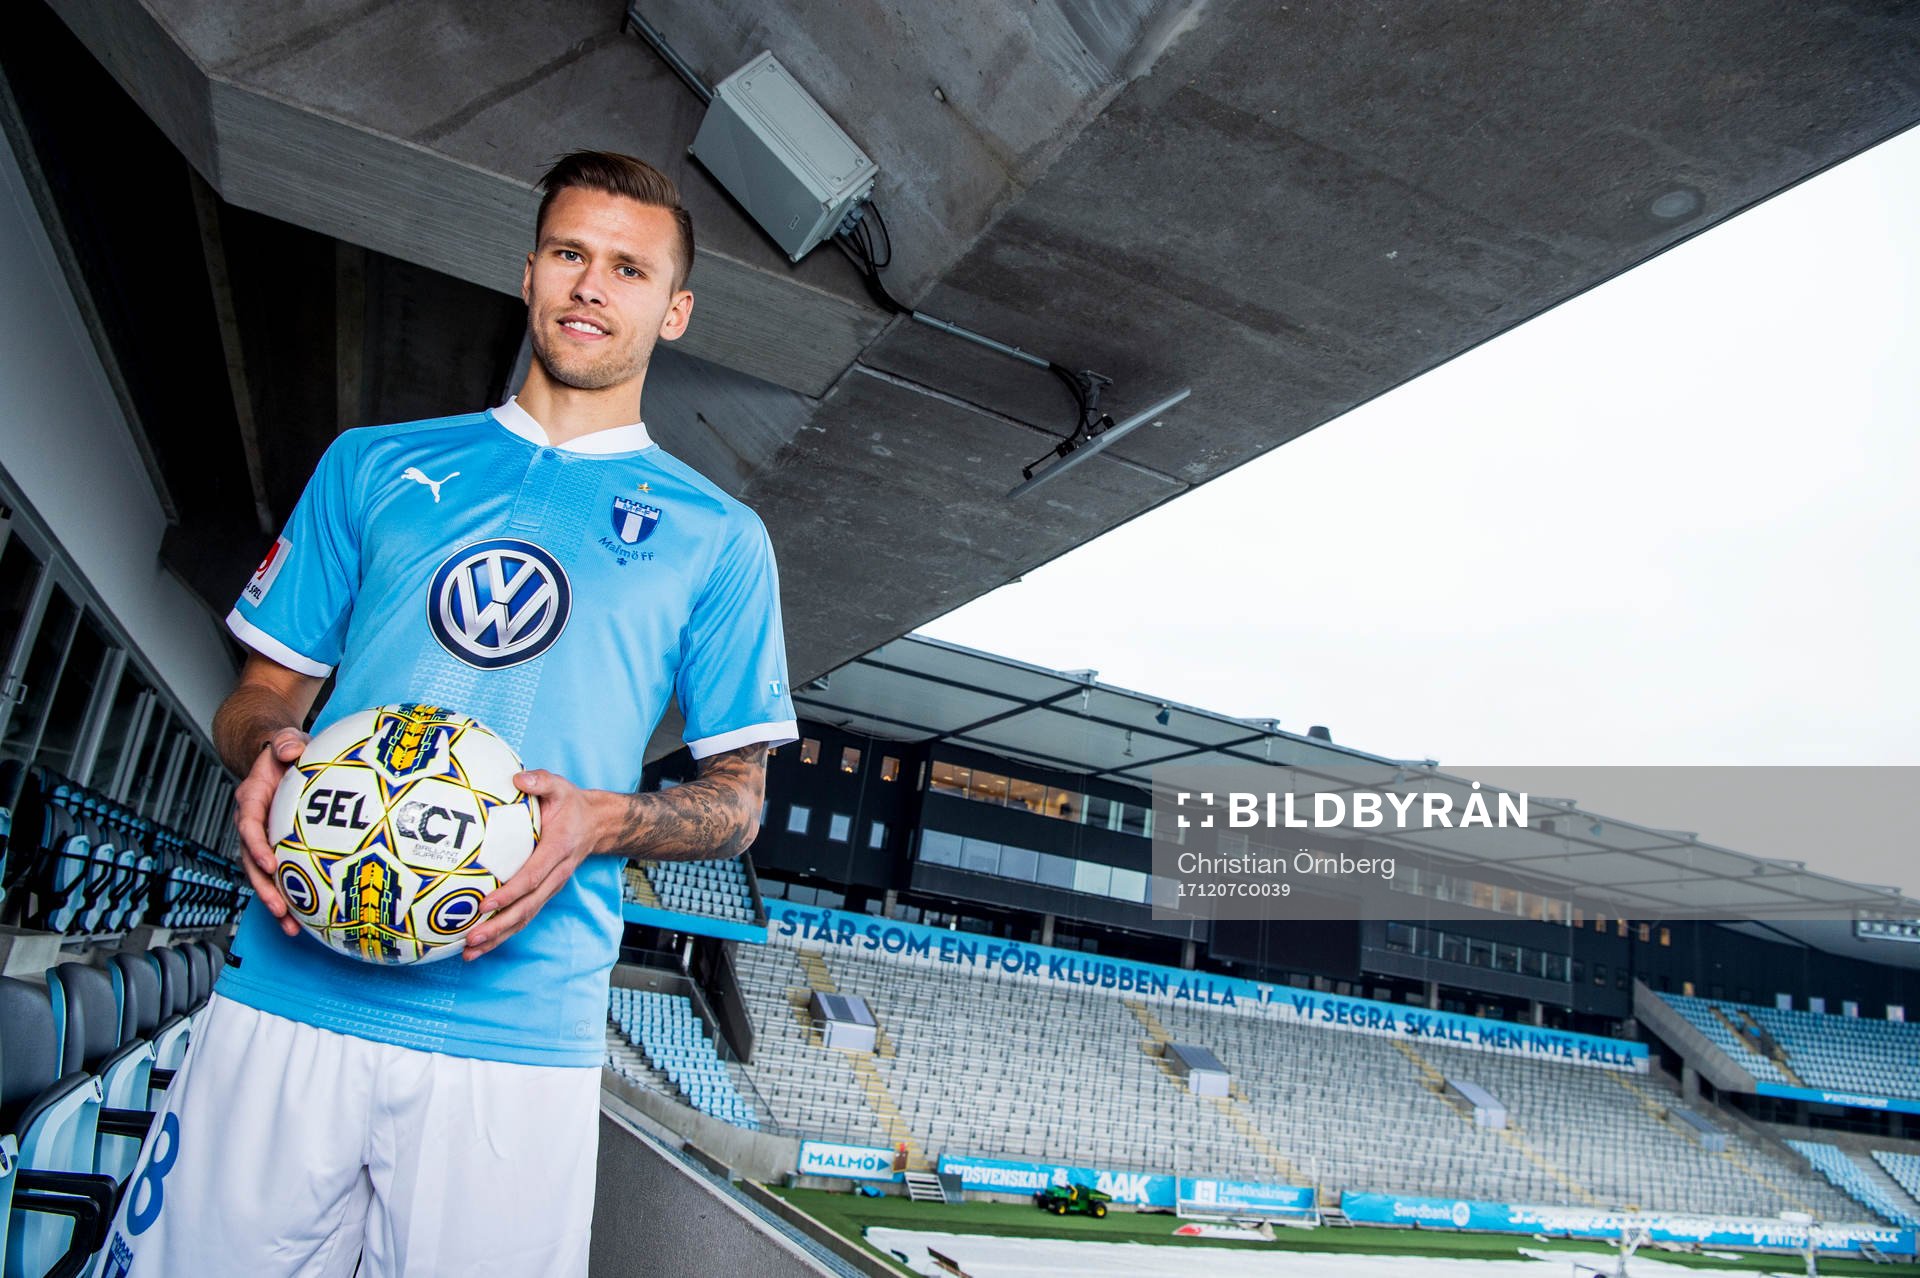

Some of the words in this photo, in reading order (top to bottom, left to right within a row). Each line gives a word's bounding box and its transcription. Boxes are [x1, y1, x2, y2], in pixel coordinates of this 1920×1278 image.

[248, 584, 263, 600] SPEL
[778, 909, 857, 947] STÅR
[863, 923, 931, 959] SOM
[939, 936, 978, 966] EN
[985, 941, 1042, 977] FÖR
[1048, 954, 1169, 997] KLUBBEN
[1175, 977, 1237, 1008] ALLA
[1291, 994, 1315, 1020] VI
[1321, 999, 1397, 1033] SEGRA
[1403, 1011, 1473, 1044] SKALL
[1478, 1024, 1523, 1051] MEN
[1529, 1030, 1574, 1059] INTE
[1578, 1040, 1636, 1068] FALLA
[126, 1111, 180, 1236] 8
[808, 1152, 876, 1171] MALMÖ
